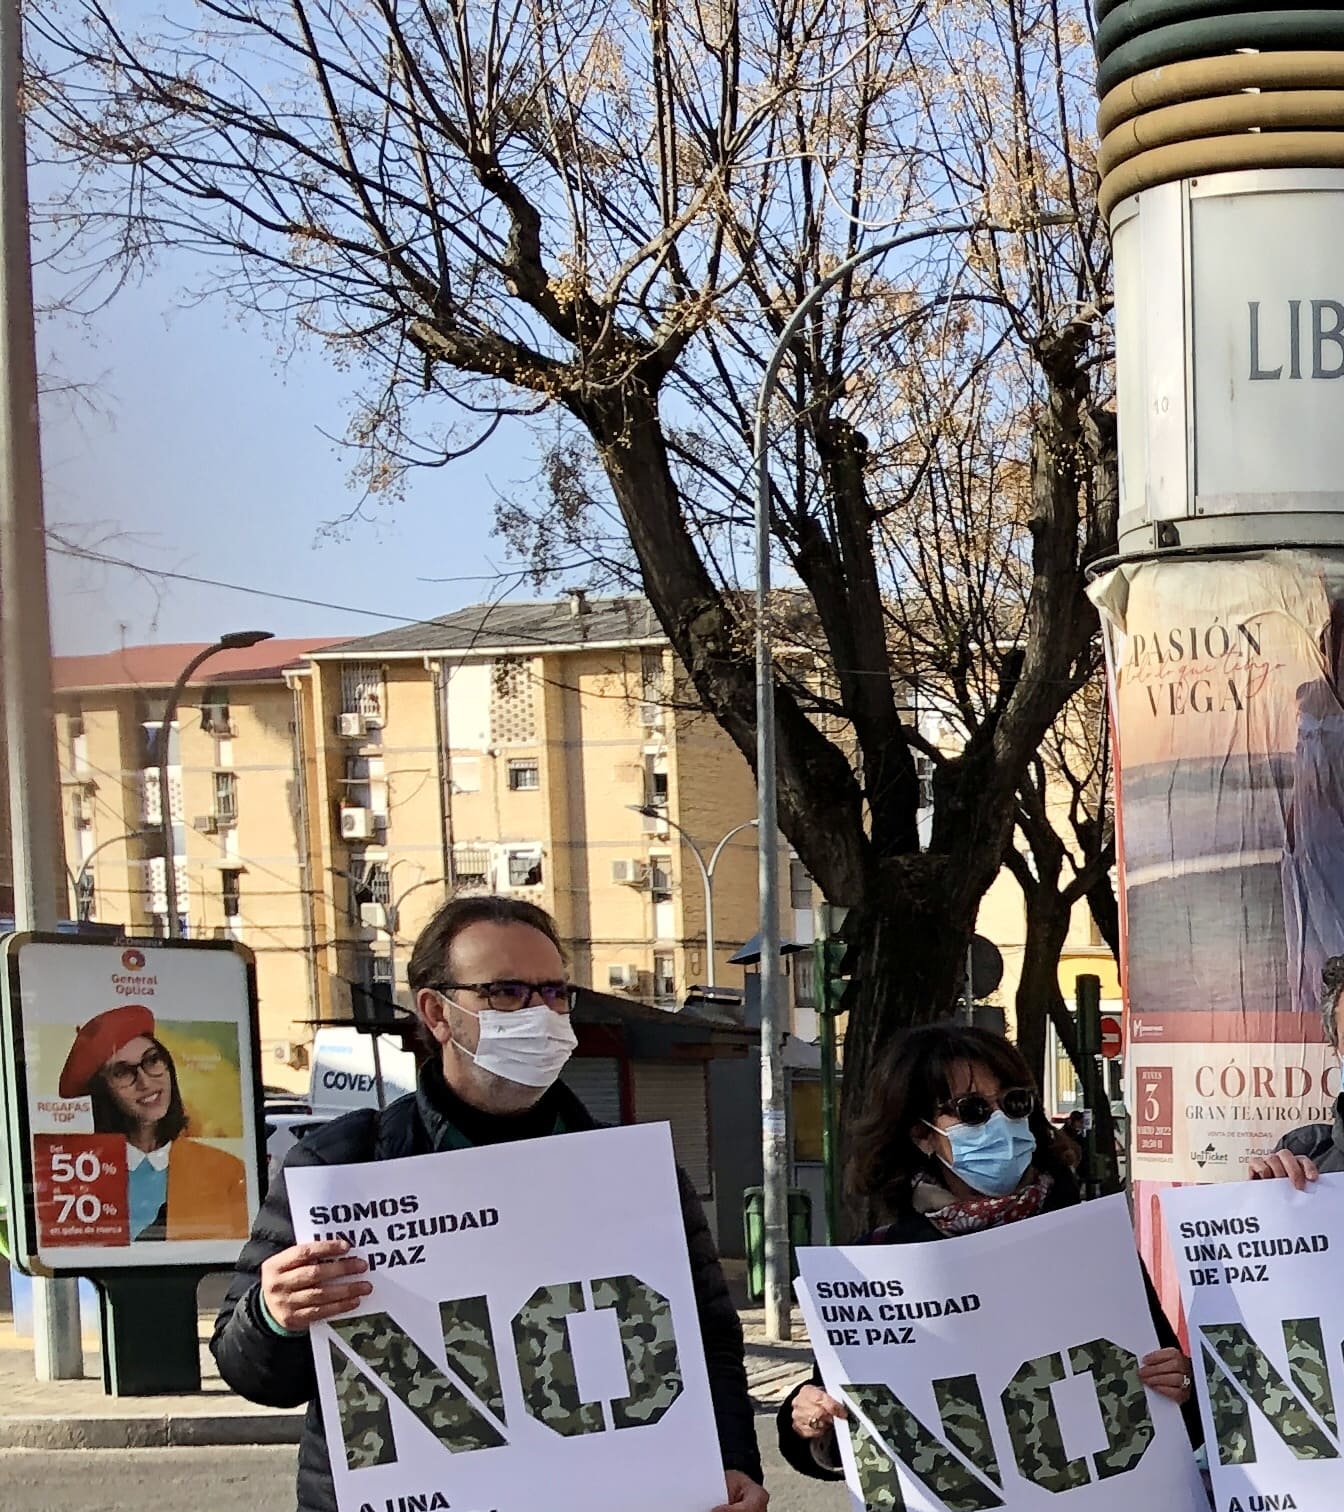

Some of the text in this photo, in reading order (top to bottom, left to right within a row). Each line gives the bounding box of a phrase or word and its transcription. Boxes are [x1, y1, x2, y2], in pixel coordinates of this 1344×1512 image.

[1133, 617, 1263, 667] PASIÓN
[1146, 680, 1246, 717] VEGA
[111, 974, 158, 985] General
[1144, 1084, 1160, 1121] 3
[1185, 1105, 1225, 1120] GRAN
[1231, 1105, 1300, 1121] TEATRO
[52, 1112, 76, 1122] TOP
[50, 1153, 117, 1182] 50%
[53, 1195, 118, 1223] 70%
[310, 1194, 419, 1225] SOMOS
[387, 1207, 499, 1242] CIUDAD
[1180, 1216, 1260, 1238] SOMOS
[368, 1244, 426, 1271] PAZ
[1184, 1234, 1329, 1262] UNA CIUDAD
[816, 1279, 904, 1299] SOMOS
[1189, 1264, 1269, 1286] DE PAZ
[821, 1294, 980, 1323] UNA CIUDAD
[827, 1327, 916, 1346] DE PAZ
[328, 1273, 684, 1471] NO
[1228, 1493, 1297, 1512] A UNA
